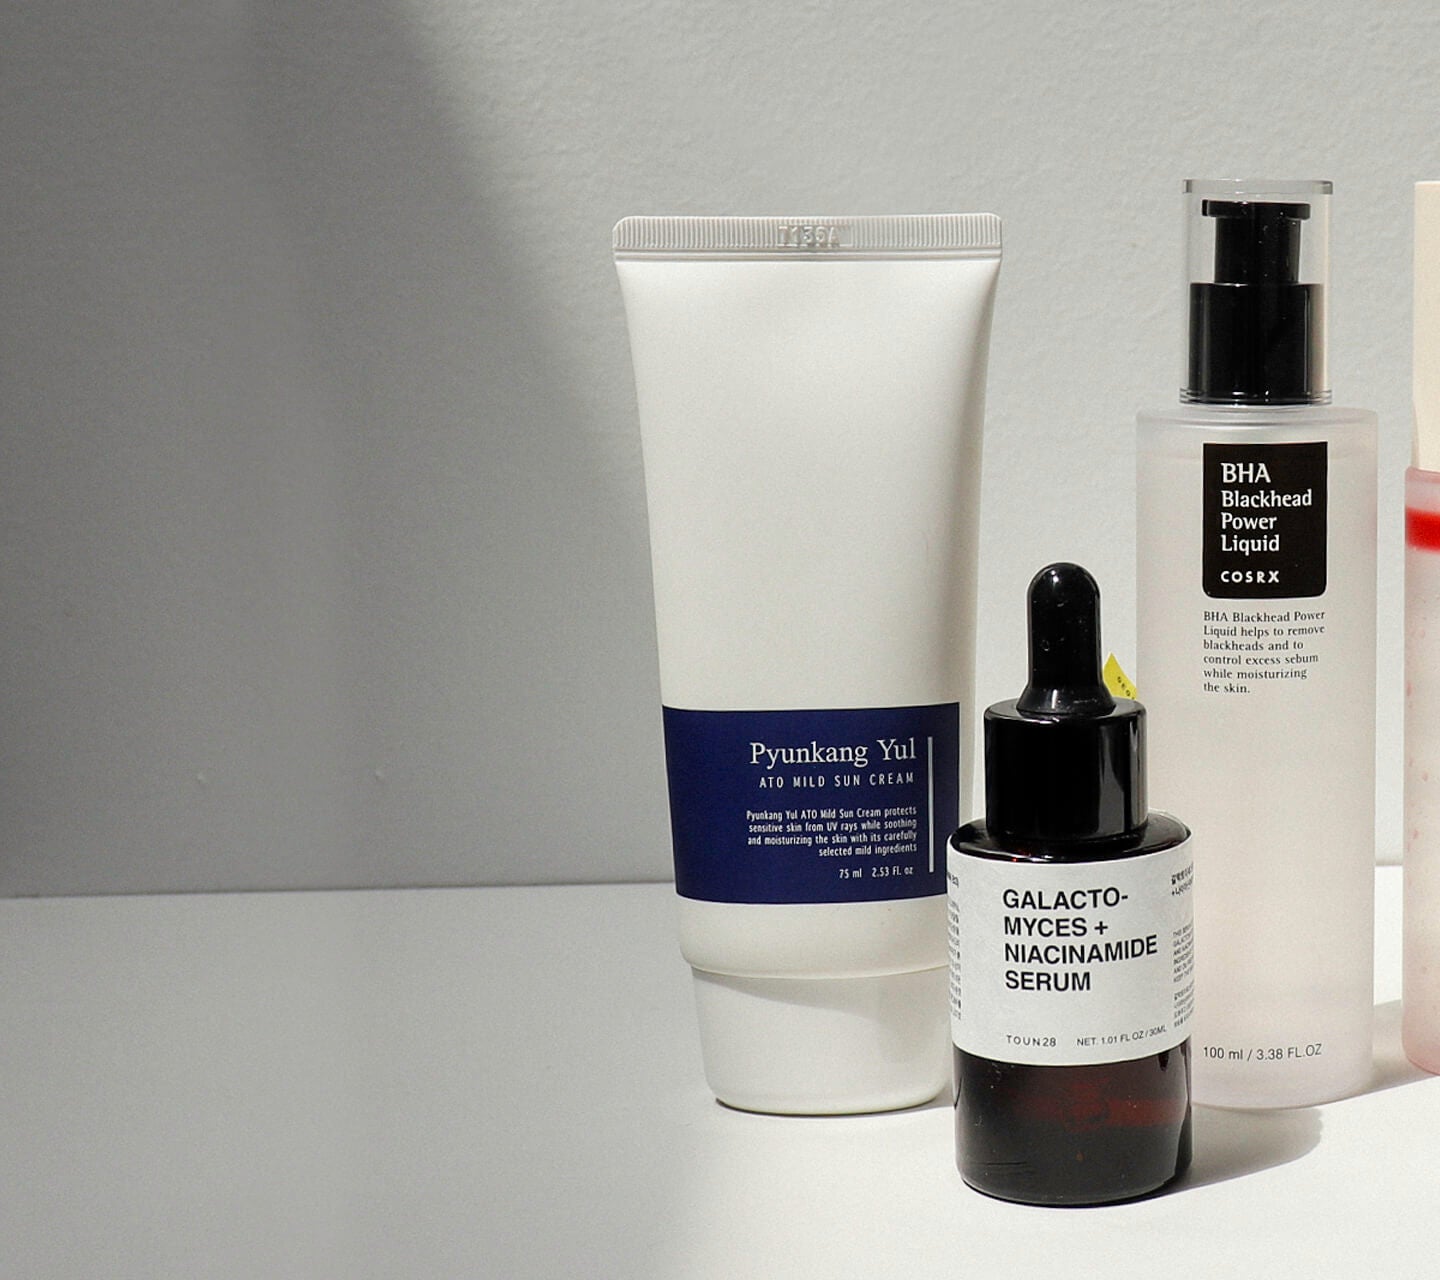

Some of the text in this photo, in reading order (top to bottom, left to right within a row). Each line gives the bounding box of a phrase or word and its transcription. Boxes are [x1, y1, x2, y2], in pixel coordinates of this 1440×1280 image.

[1220, 462, 1271, 484] BHA
[1221, 488, 1312, 508] Blackhead
[1221, 512, 1277, 530] Power
[1221, 534, 1280, 556] Liquid
[1220, 570, 1280, 583] COSRX
[1203, 611, 1325, 623] BHA Blackhead Power
[1203, 625, 1325, 639] Liquid helps to remove
[1203, 639, 1304, 651] blackheads and to
[1203, 653, 1319, 665] control excess sebum
[1203, 668, 1308, 680] while moisturizing
[1203, 683, 1251, 693] the skin.
[750, 737, 917, 769] Pyunkang Yul
[759, 772, 914, 789] ATO MILD SUN CREAM
[746, 806, 917, 822] Pyunkang Yul ATO Mild Sun Cream protects
[748, 818, 917, 833] sensitive skin from UV rays while soothing
[748, 830, 917, 847] and moisturizing the skin with its carefully
[818, 843, 917, 857] selected mild ingredients
[839, 869, 849, 878] 75
[852, 868, 862, 878] ml
[871, 866, 889, 878] 2.53
[904, 866, 914, 875] oz
[1003, 887, 1129, 909] GALACTO-
[1004, 916, 1087, 937] MYCES
[1004, 934, 1158, 964] NIACINAMIDE
[1005, 970, 1091, 992] SERUM
[1101, 1035, 1118, 1045] 1.01
[1120, 1033, 1131, 1043] FL
[1132, 1030, 1144, 1041] OZ
[1203, 1047, 1224, 1059] 100
[1228, 1048, 1243, 1060] ml
[1256, 1048, 1283, 1060] 3.38
[1288, 1043, 1322, 1058] FL.OZ
